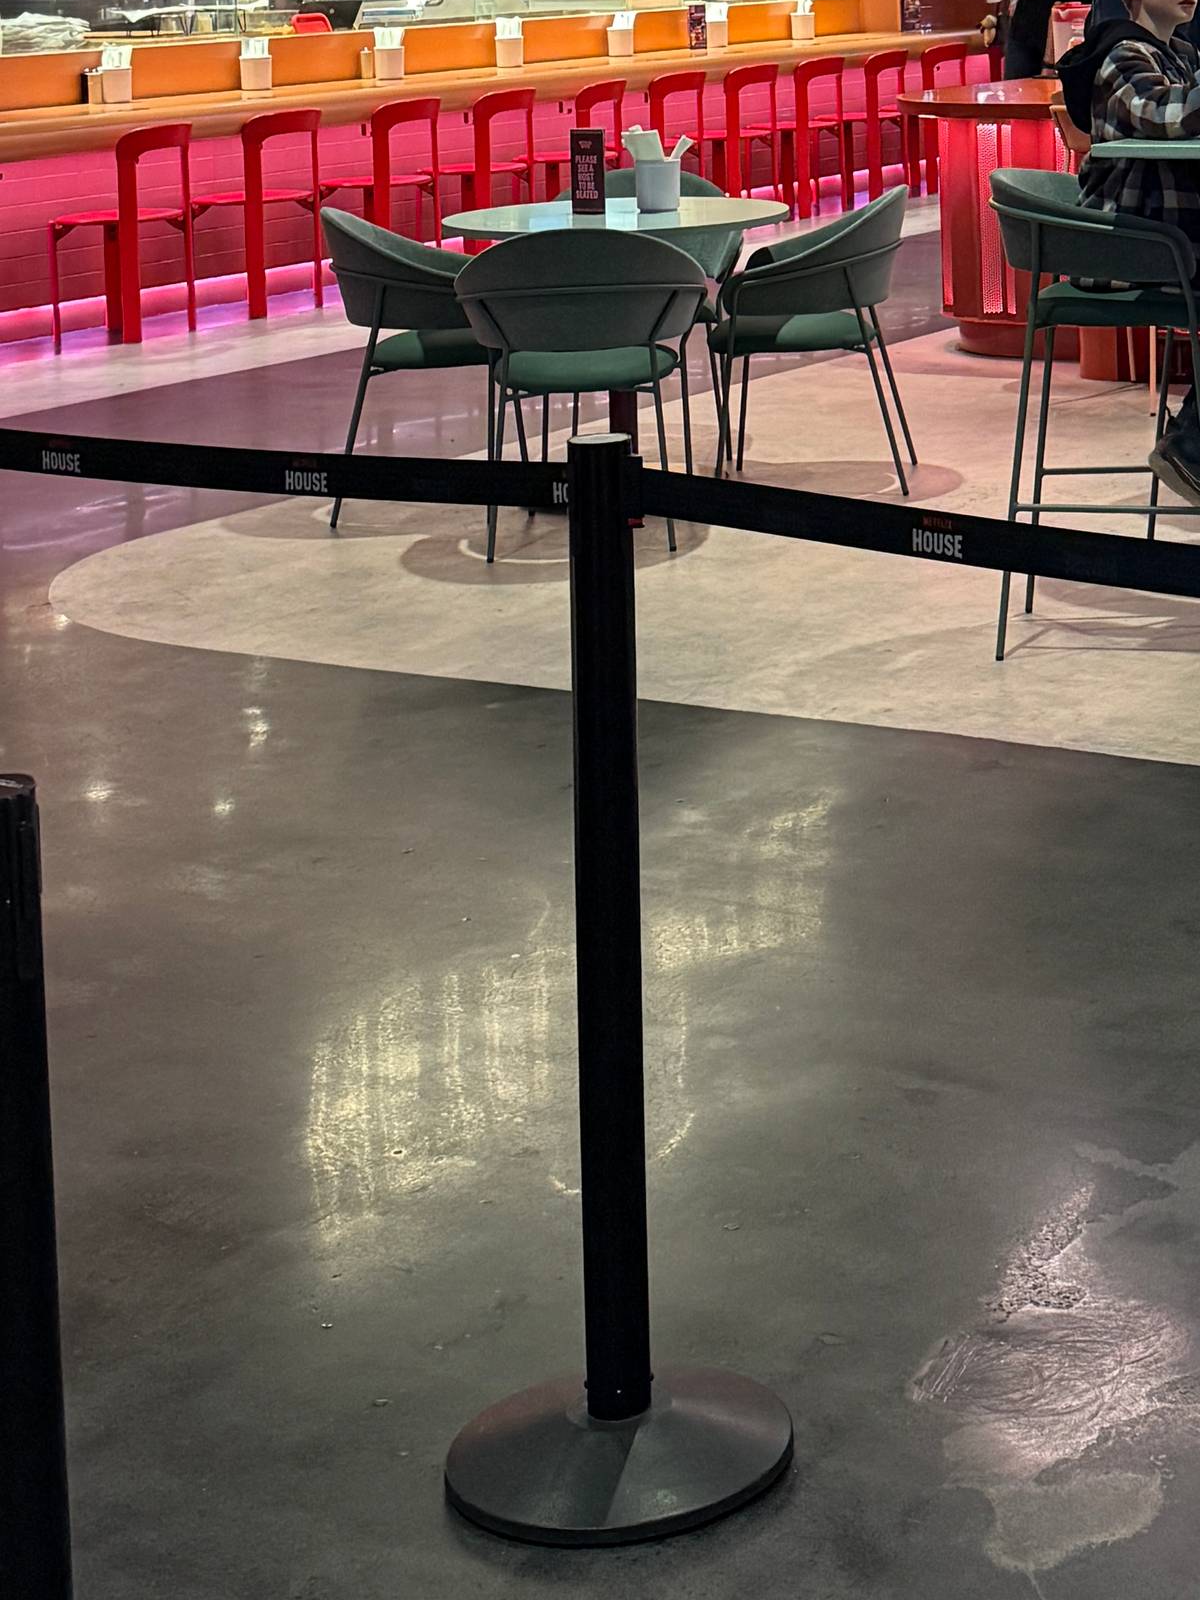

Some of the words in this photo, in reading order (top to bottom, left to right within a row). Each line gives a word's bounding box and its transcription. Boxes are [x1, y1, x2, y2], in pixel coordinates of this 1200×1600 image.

[575, 155, 597, 164] PLEASE
[576, 190, 598, 200] SEATED
[42, 449, 81, 473] HOUSE
[285, 470, 328, 493] HOUSE
[912, 527, 963, 559] HOUSE
